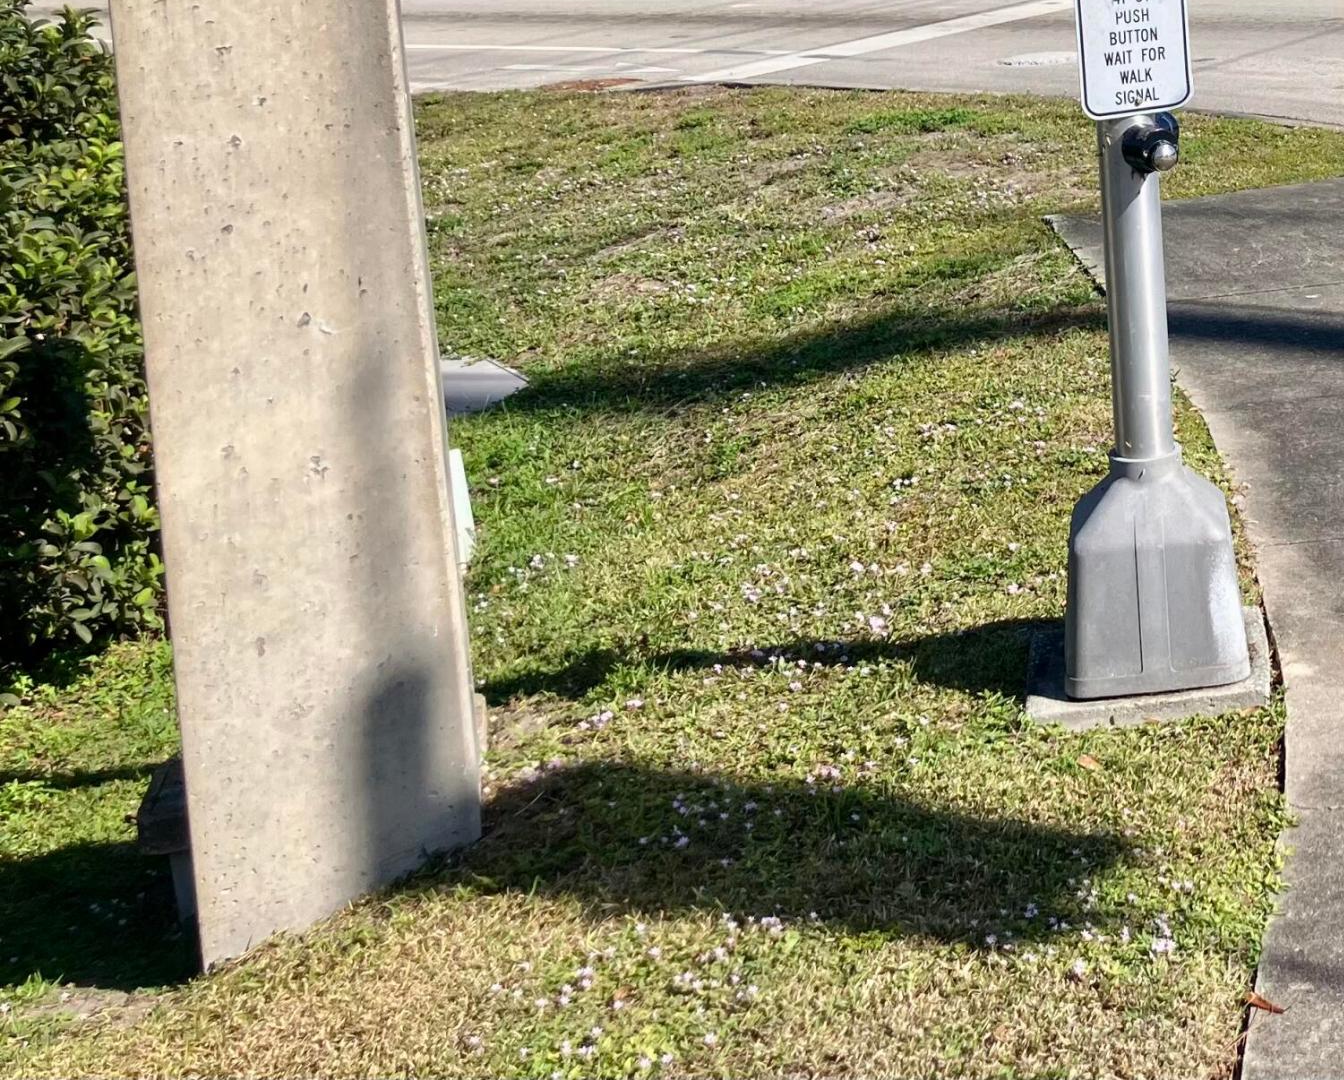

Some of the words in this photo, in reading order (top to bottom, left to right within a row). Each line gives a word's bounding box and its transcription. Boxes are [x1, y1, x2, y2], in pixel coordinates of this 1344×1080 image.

[1115, 8, 1150, 25] PUSH
[1109, 27, 1159, 46] BUTTON
[1104, 50, 1132, 66] WAIT
[1141, 46, 1166, 62] FOR
[1120, 68, 1153, 85] WALK
[1115, 87, 1160, 106] SIGNAL
